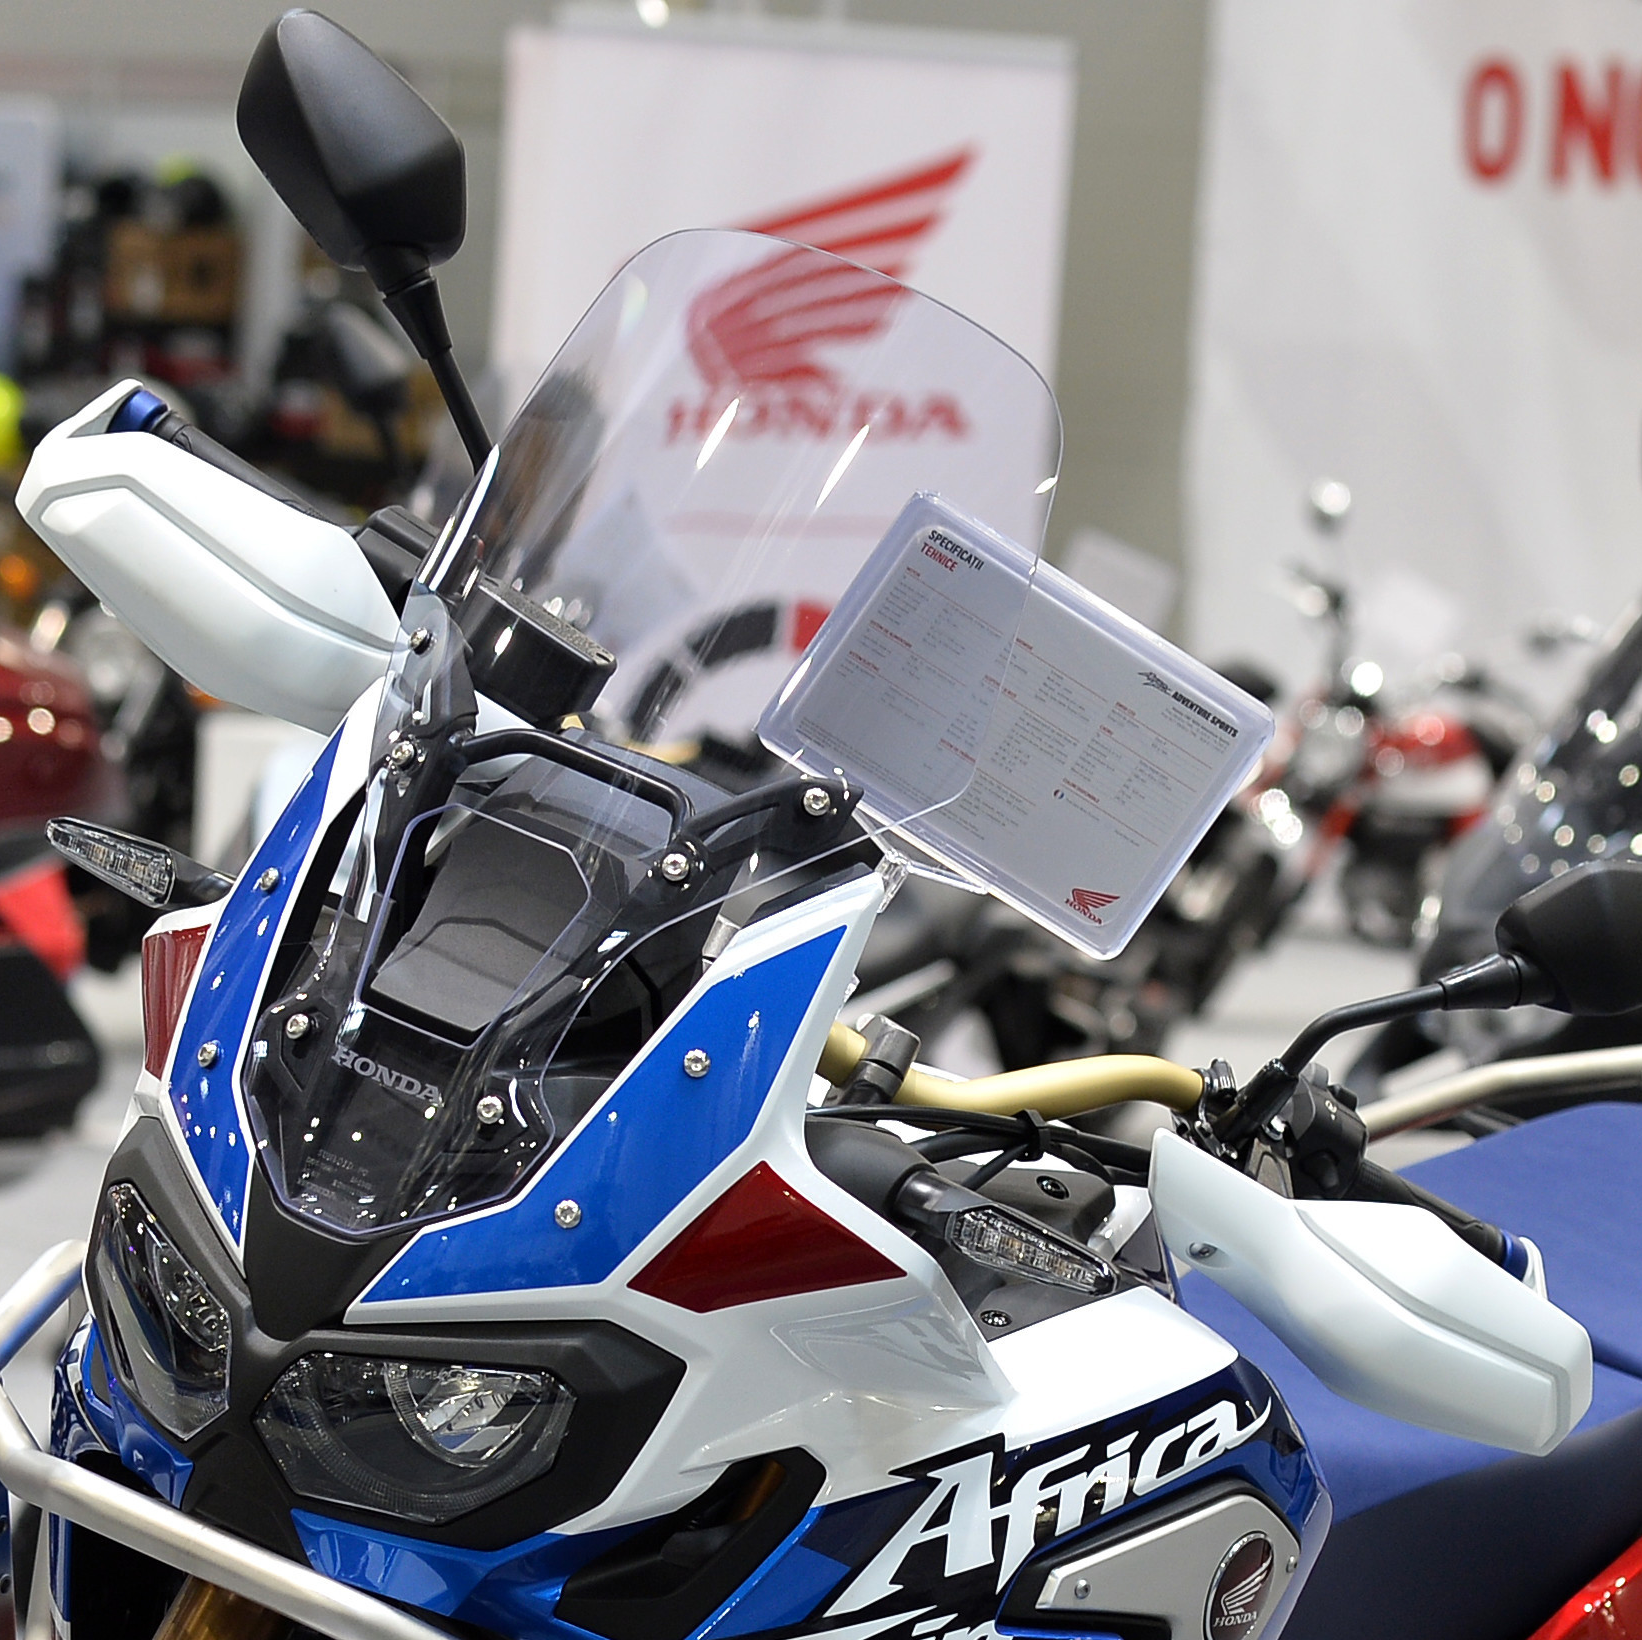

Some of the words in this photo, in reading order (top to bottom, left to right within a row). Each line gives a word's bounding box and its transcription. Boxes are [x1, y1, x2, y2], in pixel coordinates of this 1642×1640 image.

[1461, 46, 1526, 187] O
[667, 391, 970, 444] HONDA
[920, 541, 959, 573] TEHNICE
[1171, 690, 1211, 723] ADVENTURE
[1209, 712, 1239, 739] SPORTS
[1063, 897, 1105, 926] HONDA
[331, 1045, 443, 1108] HONDA
[823, 1397, 1272, 1618] Africa
[1212, 1611, 1258, 1628] HONDA
